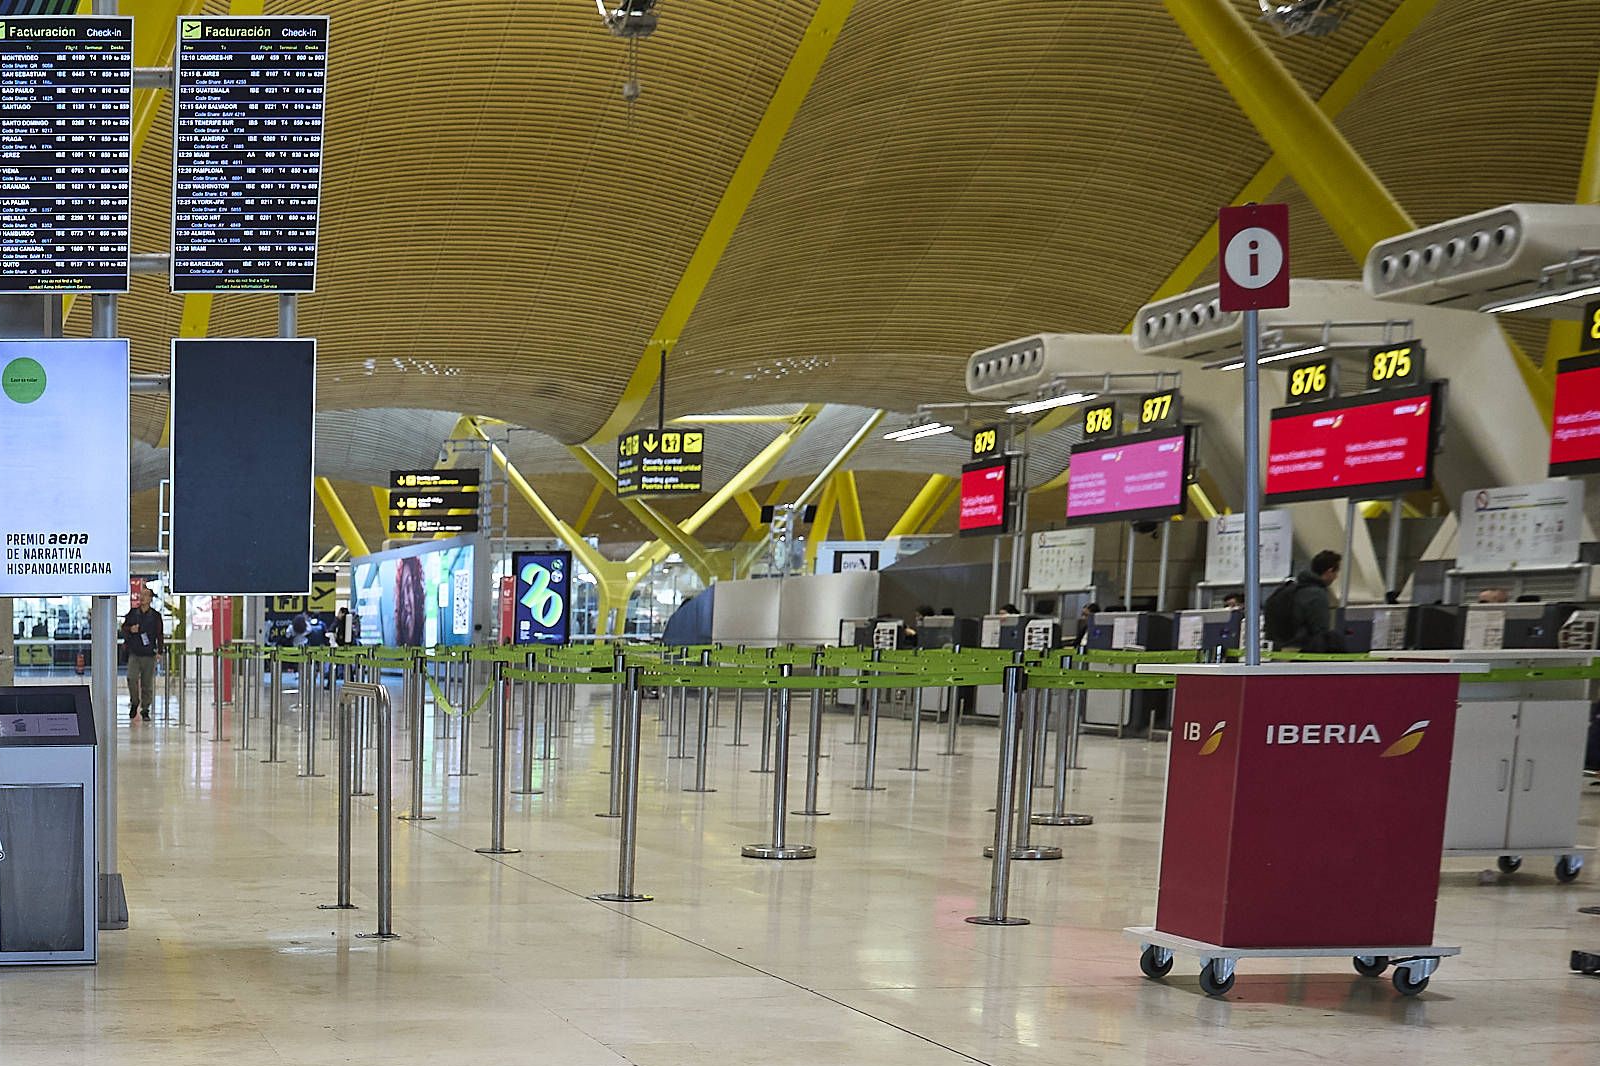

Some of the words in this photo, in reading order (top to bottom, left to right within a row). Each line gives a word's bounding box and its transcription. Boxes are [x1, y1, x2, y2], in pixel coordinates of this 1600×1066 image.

[10, 27, 75, 36] Facturación
[86, 28, 122, 36] Check-in
[206, 26, 270, 36] Facturación
[282, 28, 316, 36] Check-in
[1372, 348, 1411, 381] 875
[1291, 364, 1327, 396] 876
[1141, 395, 1172, 423] 877
[1086, 408, 1112, 433] 878
[974, 430, 996, 454] 879
[7, 533, 45, 545] PREMIO
[48, 533, 88, 544] aena
[7, 549, 19, 560] DE
[23, 548, 81, 559] NARRATIVA
[7, 562, 111, 575] HISPANOAMERICANA
[520, 563, 563, 627] 20
[1184, 722, 1200, 742] IB
[1266, 724, 1381, 745] IBERIA
